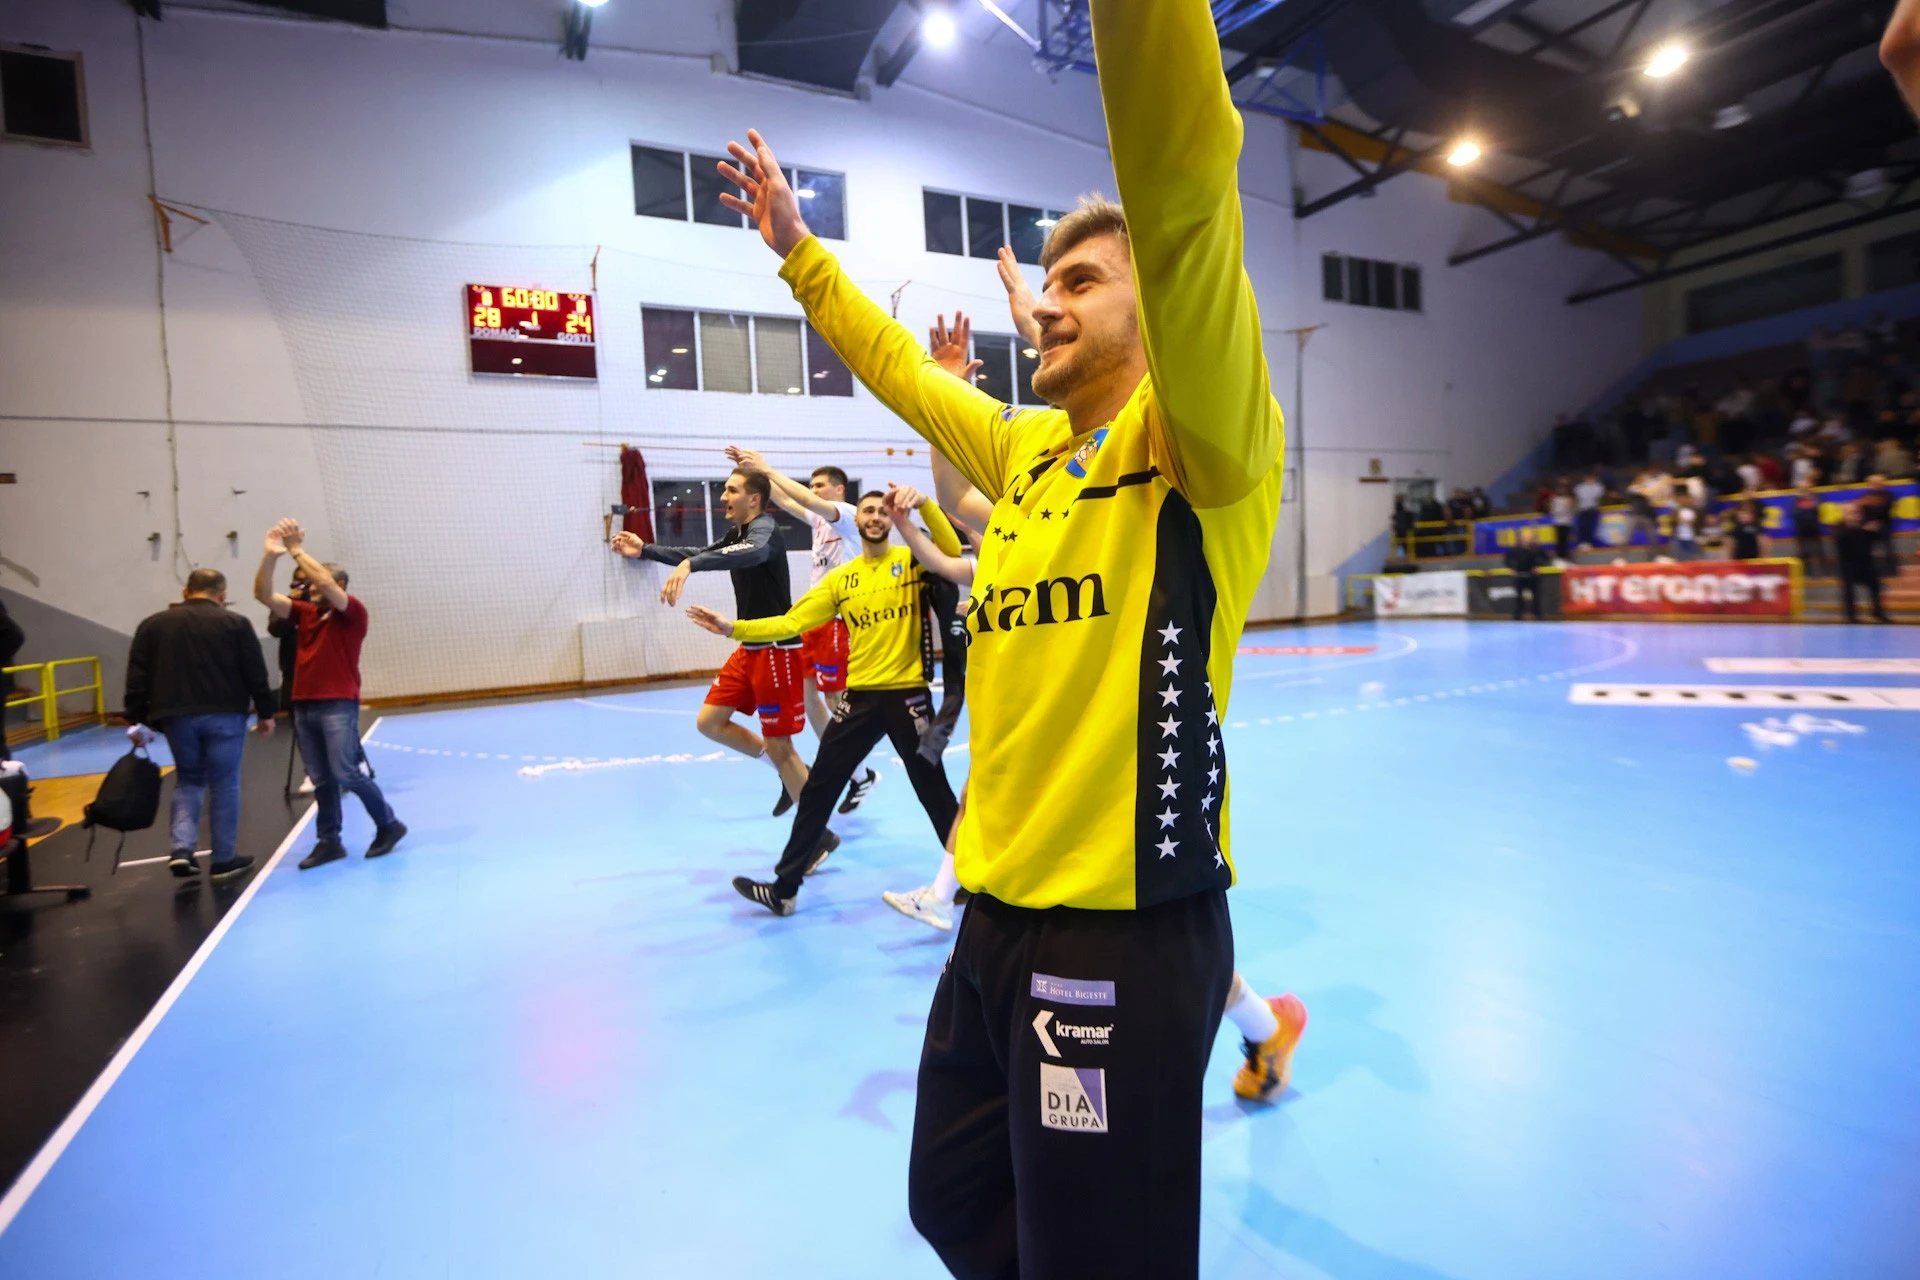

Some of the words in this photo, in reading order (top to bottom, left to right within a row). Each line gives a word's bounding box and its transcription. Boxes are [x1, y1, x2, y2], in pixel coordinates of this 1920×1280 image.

[473, 306, 501, 327] 28
[565, 313, 592, 334] 24
[844, 572, 859, 590] 16
[1050, 986, 1073, 999] HOTEL
[1075, 990, 1108, 1000] BIGESTE
[1055, 1020, 1113, 1039] kramar
[1048, 1091, 1091, 1113] DIA
[1048, 1113, 1100, 1129] GRUPA
